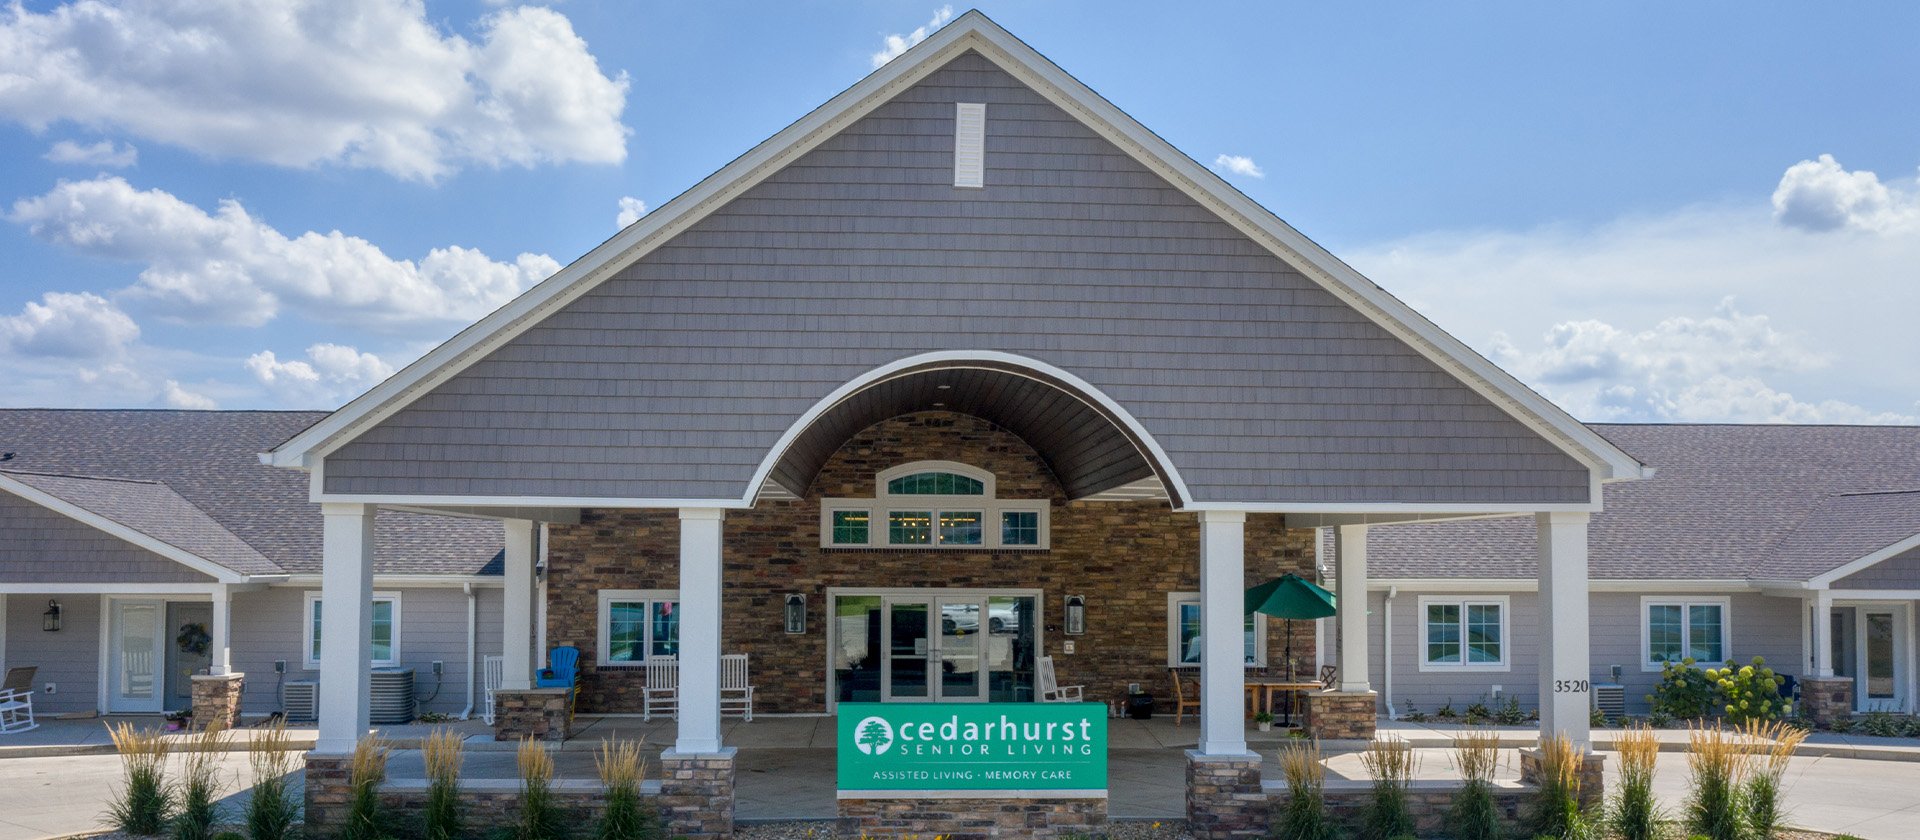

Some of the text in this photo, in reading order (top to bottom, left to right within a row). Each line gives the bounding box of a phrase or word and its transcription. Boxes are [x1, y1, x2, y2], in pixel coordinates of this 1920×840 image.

[1554, 679, 1588, 693] 3520
[900, 714, 1091, 741] cedarhurst
[900, 744, 1091, 755] SENIOR LIVING
[873, 770, 1072, 780] ASSISTED LIVING MEMORY CARE
